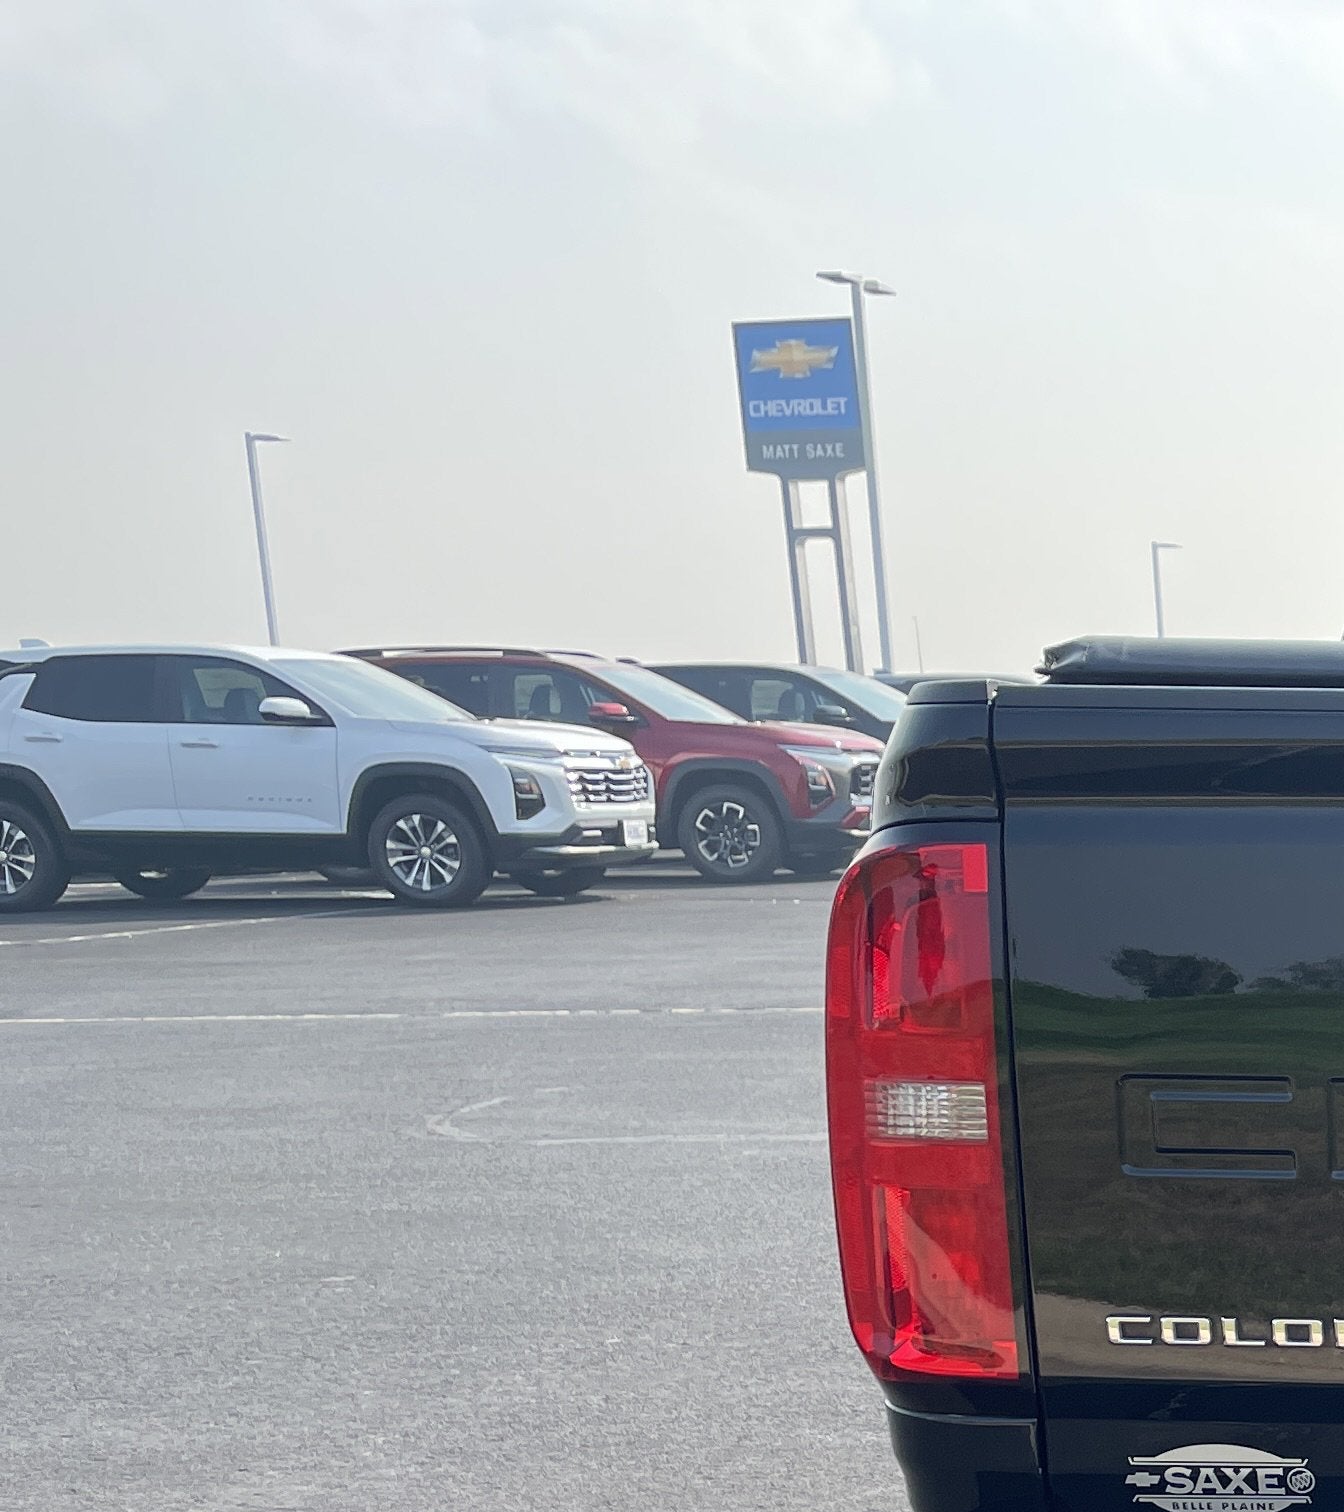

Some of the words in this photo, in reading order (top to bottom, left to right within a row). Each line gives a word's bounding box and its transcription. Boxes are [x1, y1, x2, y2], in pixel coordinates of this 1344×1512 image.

[748, 397, 848, 418] CHEVROLET
[762, 444, 800, 459] MATT
[807, 442, 845, 459] SAXE
[1163, 1466, 1286, 1496] SAXE
[1172, 1501, 1213, 1511] BELLE
[1222, 1502, 1276, 1512] PLAINE
